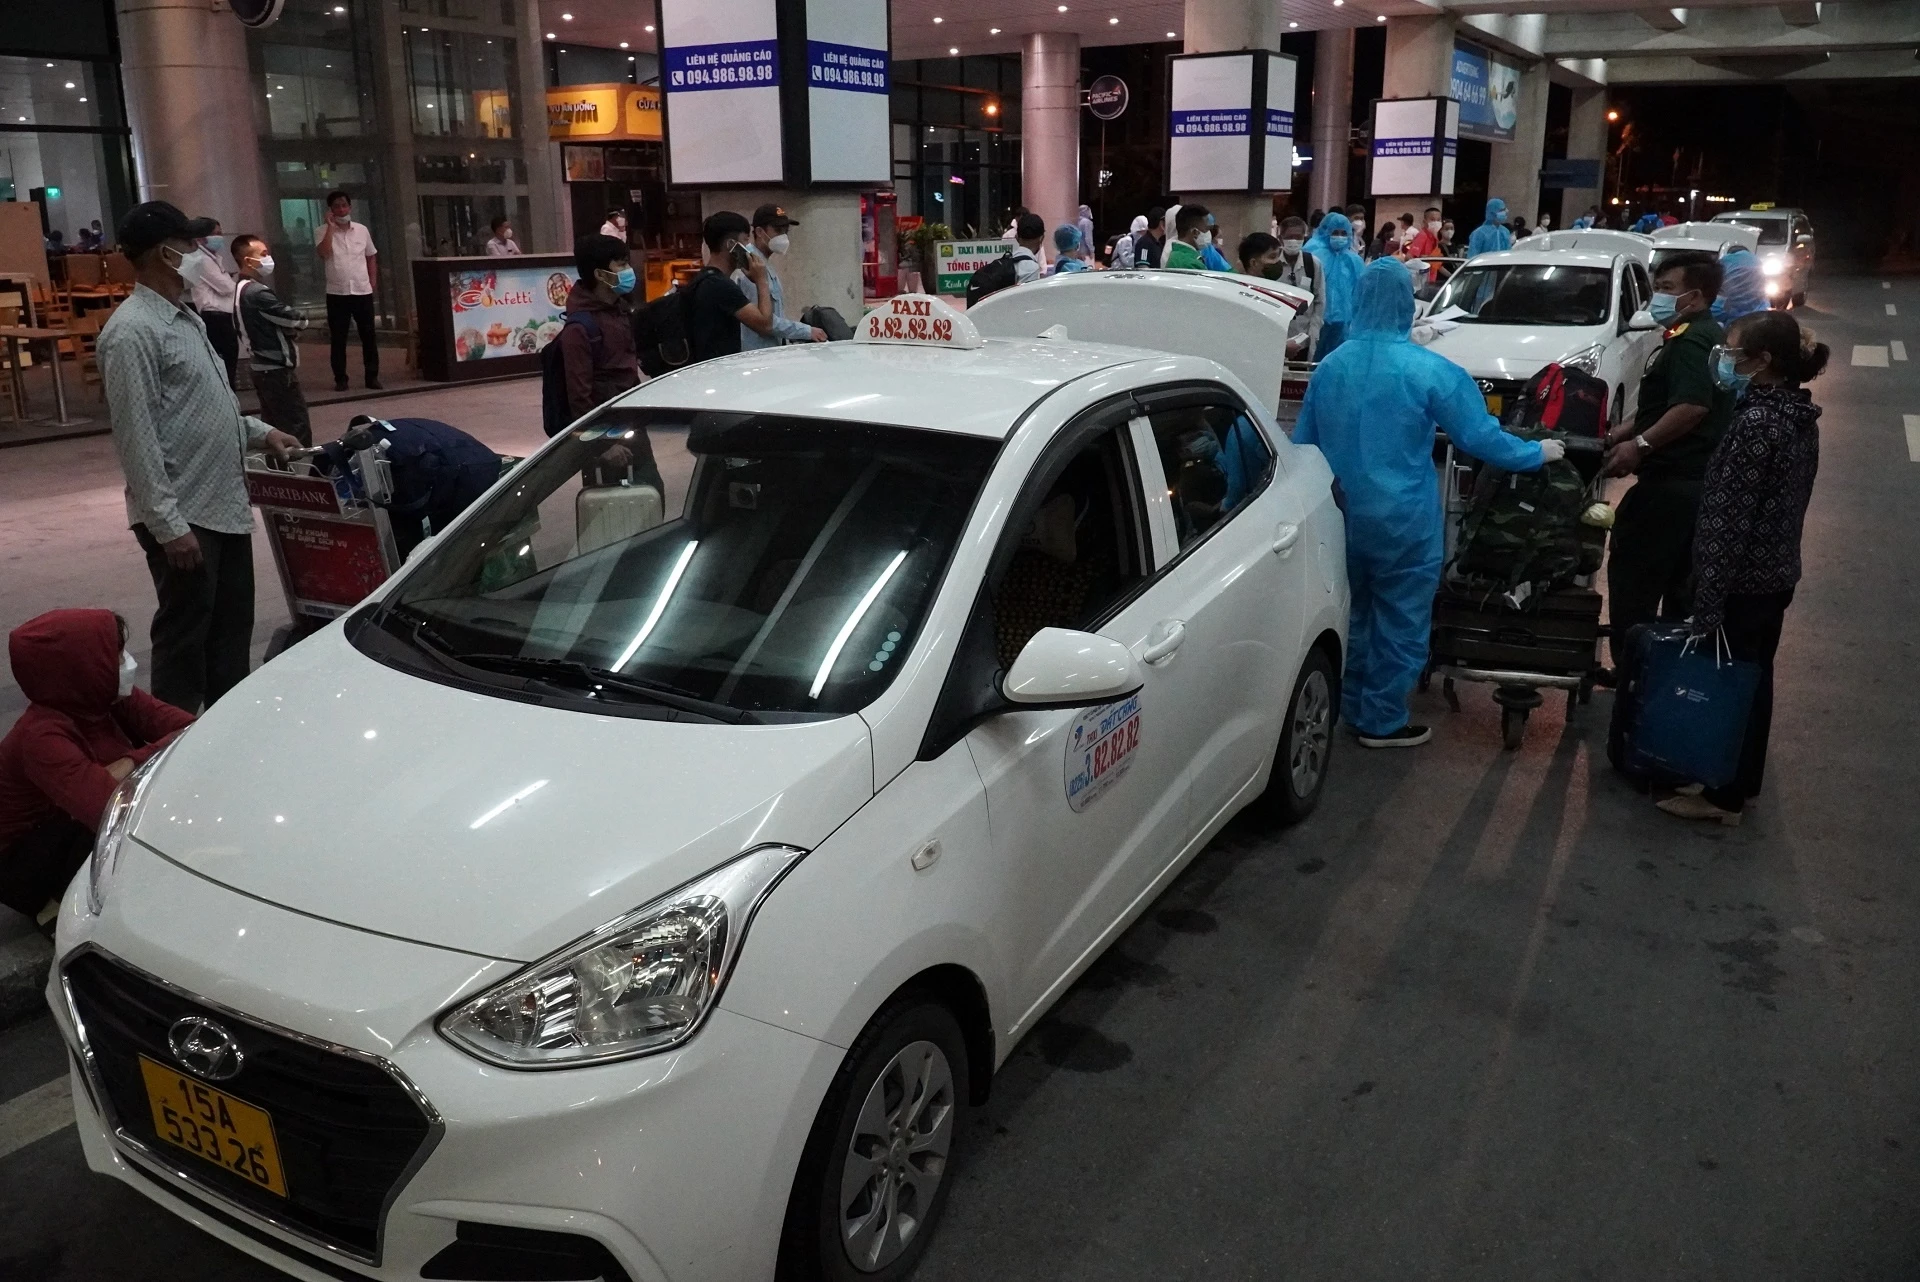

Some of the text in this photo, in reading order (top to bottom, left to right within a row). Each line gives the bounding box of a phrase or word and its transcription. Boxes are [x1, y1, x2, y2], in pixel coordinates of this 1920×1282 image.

[686, 49, 772, 67] LIÊN HỆ QUẢNG CÁO
[823, 52, 884, 70] LIÊN HỆ QUẢNG CÁO
[686, 65, 773, 86] 094.986.98.98
[823, 67, 885, 88] 094.986.98.98
[957, 244, 1013, 255] TAXI MAI LINH
[946, 257, 970, 272] TỔNG
[891, 299, 931, 317] TAXI
[869, 316, 953, 341] 3.82.82.82
[262, 485, 330, 505] AGRIBANK
[178, 1079, 237, 1134] 15A
[162, 1105, 270, 1185] 533.26
